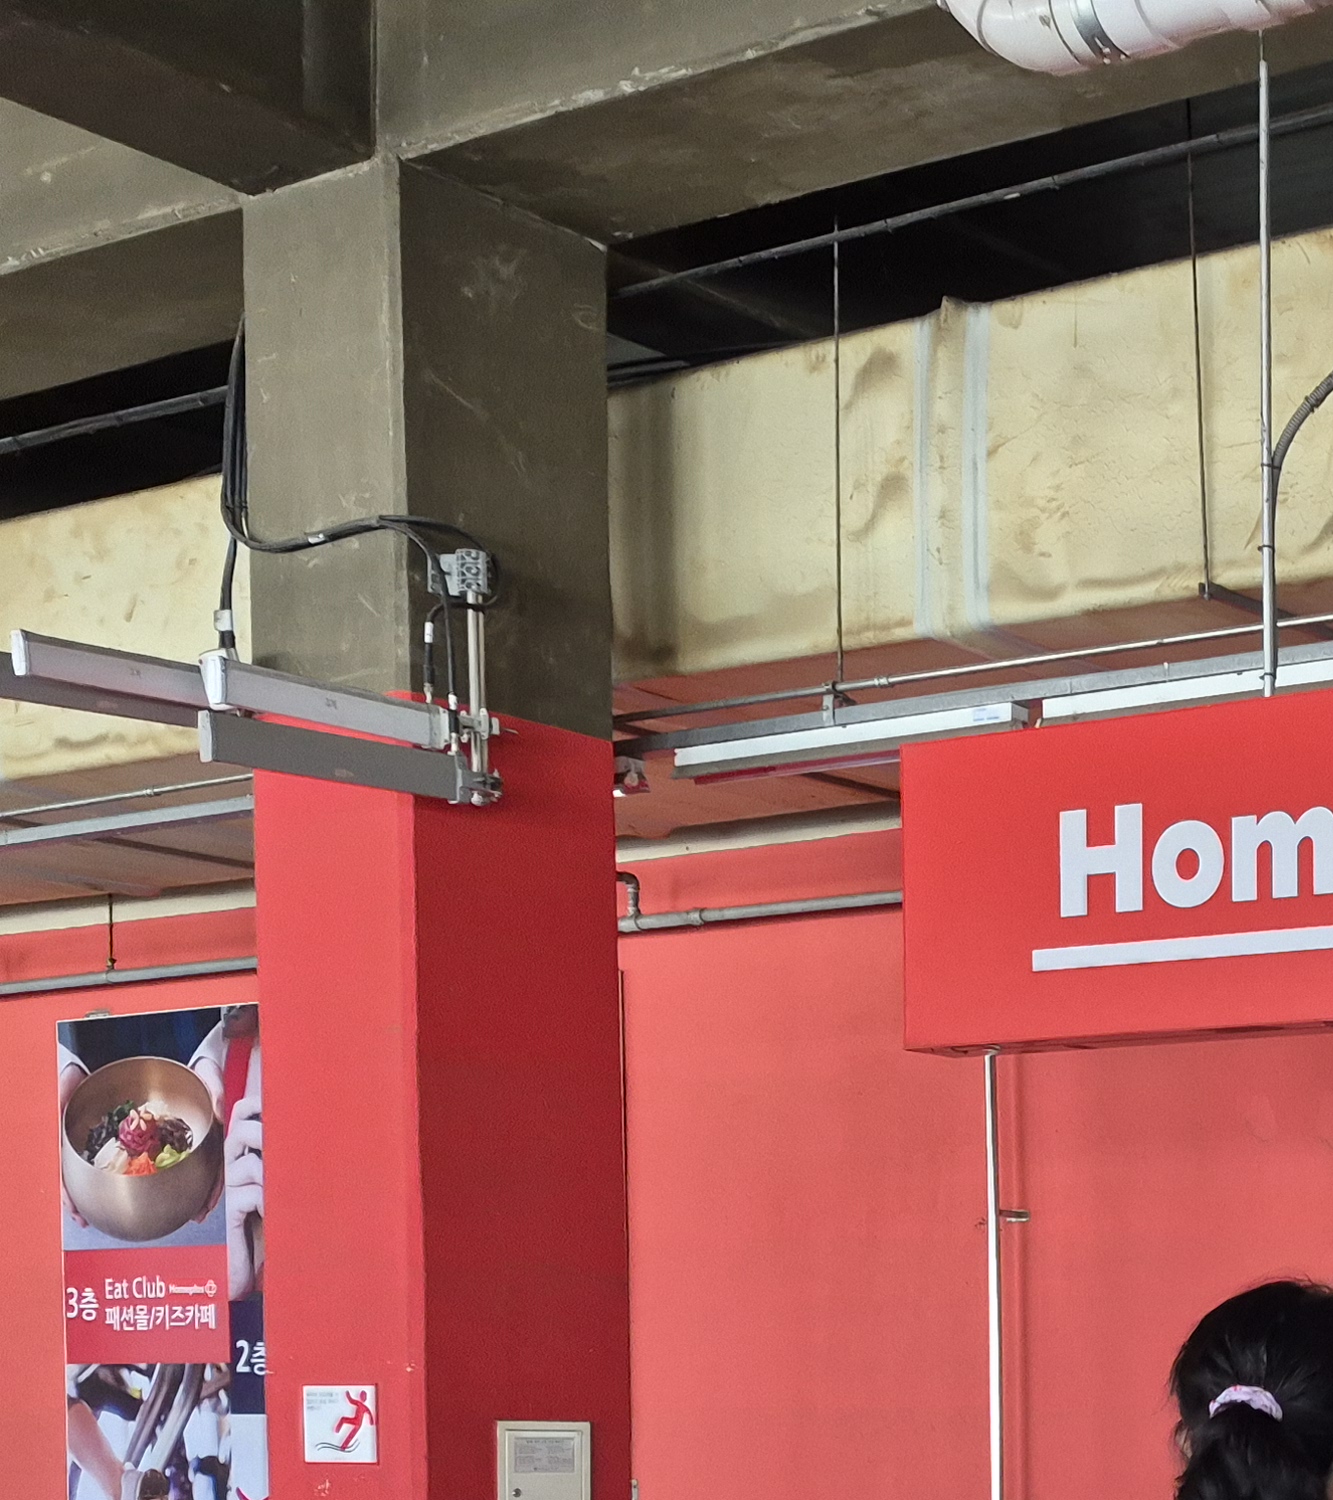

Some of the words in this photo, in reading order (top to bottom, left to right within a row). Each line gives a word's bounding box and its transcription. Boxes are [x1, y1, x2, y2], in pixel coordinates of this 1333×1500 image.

[104, 1278, 129, 1300] Eat
[132, 1275, 165, 1299] Club
[66, 1287, 99, 1321] 3층
[105, 1303, 217, 1331] 패션몰/키즈카페
